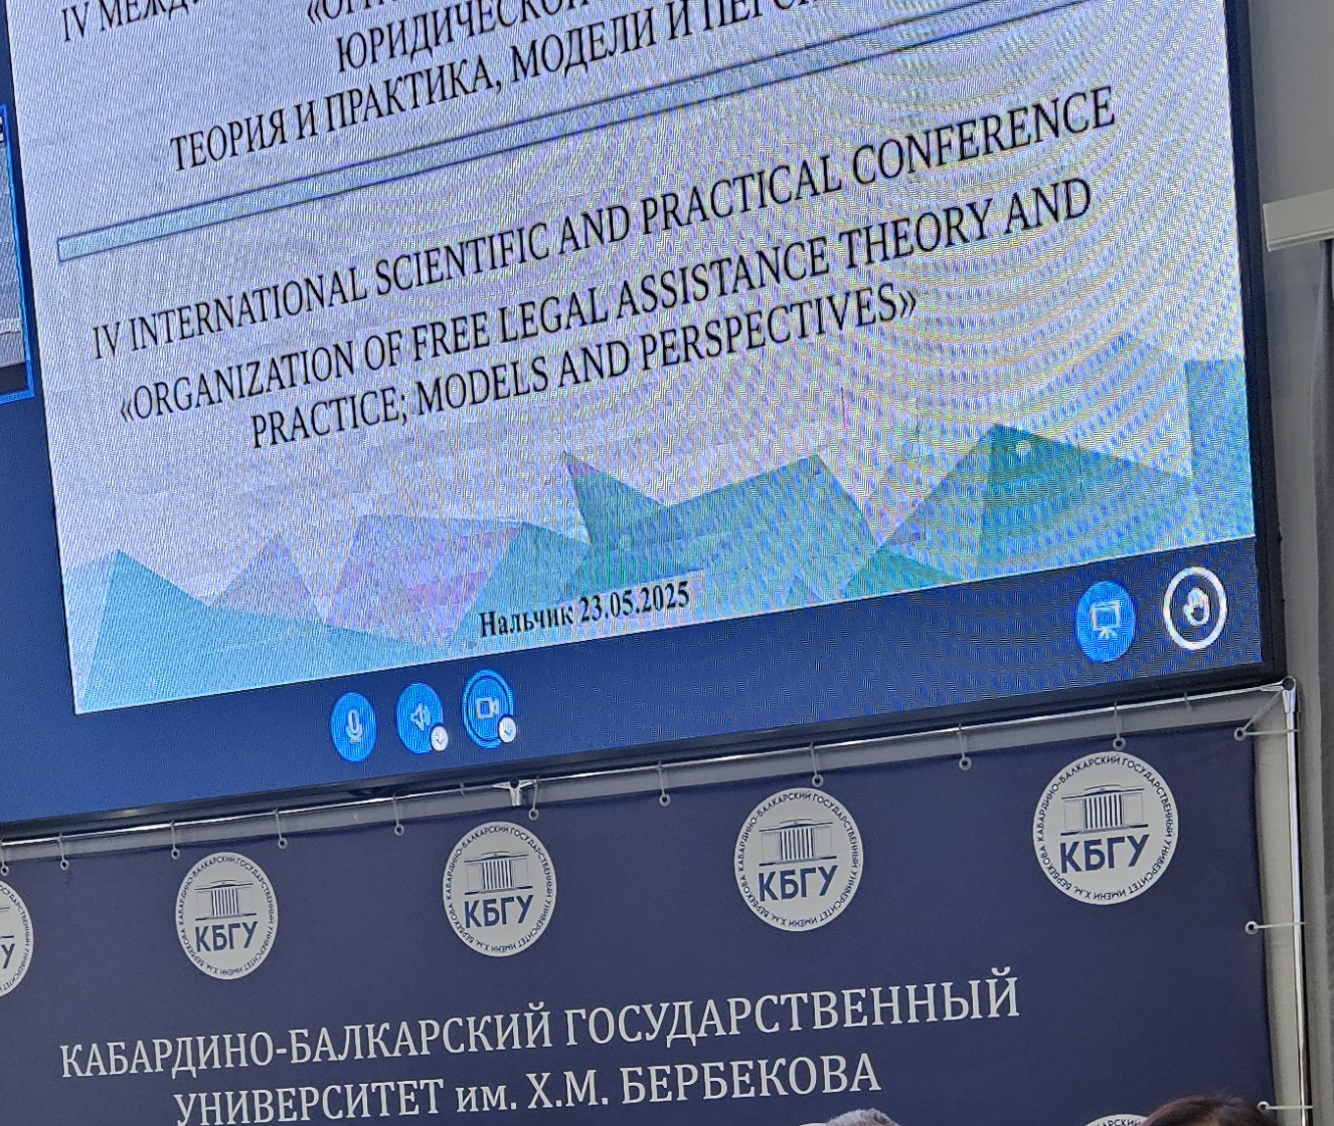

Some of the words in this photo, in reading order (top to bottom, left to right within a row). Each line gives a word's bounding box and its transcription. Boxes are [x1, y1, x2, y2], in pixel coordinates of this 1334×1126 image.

[62, 2, 89, 42] IV
[336, 0, 588, 72] ЮРИДИЧЕСК
[170, 111, 286, 171] ТЕОРИЯ
[294, 100, 318, 140] И
[324, 53, 503, 132] ПРАКТИКА,
[510, 8, 657, 81] МОДЕЛИ
[667, 0, 693, 40] И
[92, 320, 122, 359] IV
[130, 265, 369, 352] INTERNATIONAL
[374, 221, 551, 294] SCIENTIFIC
[556, 205, 631, 256] AND
[642, 155, 843, 236] PRACTICAL
[851, 86, 1116, 186] CONFERENCE
[120, 339, 357, 422] «ORGANIZATION
[364, 331, 405, 372] OF
[413, 313, 490, 361] FREE
[499, 287, 610, 343] LEGAL
[616, 236, 831, 320] ASSISTANCE
[839, 197, 995, 269] THEORY
[1003, 176, 1094, 232] AND
[251, 394, 408, 448] PRACTICE;
[415, 356, 550, 414] MODELS
[559, 340, 631, 389] AND
[640, 281, 918, 372] PERSPECTIVES»
[479, 604, 574, 638] Нальчик
[579, 580, 691, 623] 23.05.2025
[758, 865, 838, 902] КБГУ
[1060, 834, 1150, 874] КБГУ
[195, 921, 258, 952] КБГУ
[464, 894, 534, 929] КБГУ
[60, 1001, 553, 1079] КАБАРДИНО-БАЛКАРСКИЙ
[566, 966, 1020, 1047] ГОСУДАРСТВЕННЫЙ
[174, 1077, 444, 1126] УНИВЕРСИТЕТ
[455, 1083, 518, 1113] им.
[526, 1070, 610, 1110] Х.М.
[620, 1053, 882, 1106] БЕРБЕКОВА
